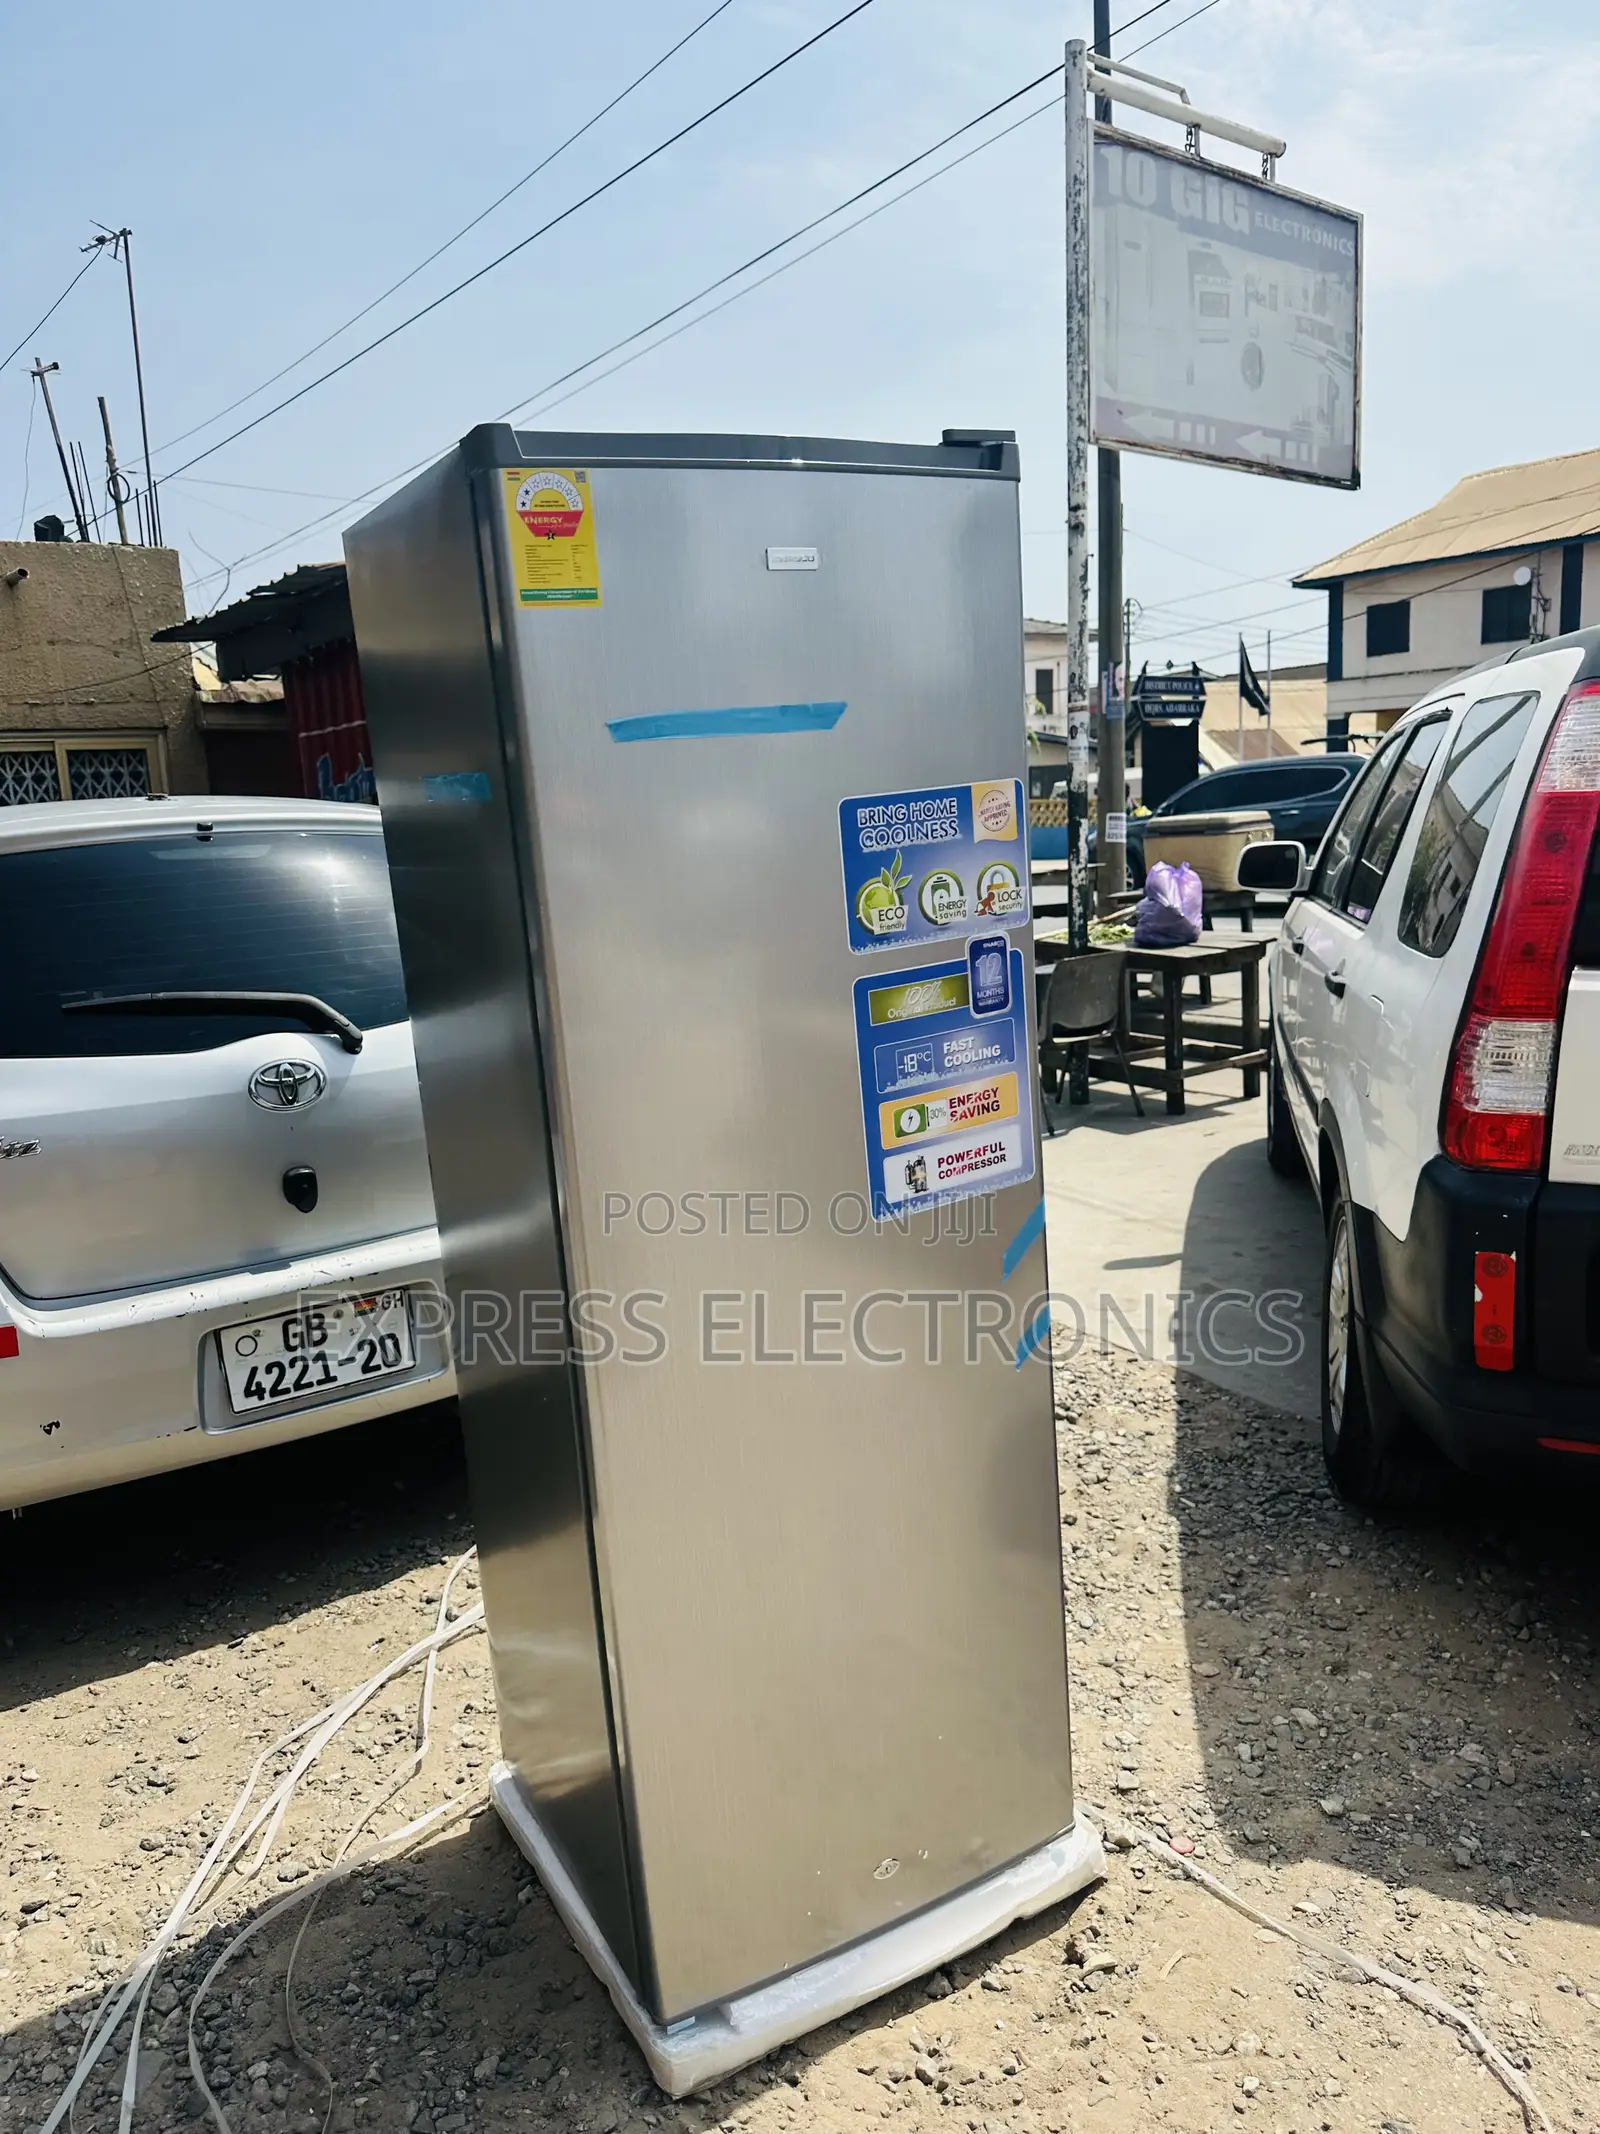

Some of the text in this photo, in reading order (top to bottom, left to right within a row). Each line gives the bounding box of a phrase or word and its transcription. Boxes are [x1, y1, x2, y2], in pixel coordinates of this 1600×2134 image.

[1100, 146, 1355, 257] 10 GIG ELECTRONICS
[525, 516, 563, 525] ENERGY
[1172, 681, 1193, 691] POLICE
[857, 797, 957, 828] BRING HOME
[859, 819, 959, 850] COOLNESS
[997, 889, 1022, 903] LOCK
[878, 906, 905, 922] ECO
[938, 899, 967, 912] ENERGY
[939, 908, 967, 920] saving
[998, 901, 1023, 912] security
[879, 919, 906, 932] friendly
[975, 952, 1003, 987] 12
[977, 987, 1005, 1000] MONTHS
[888, 1003, 923, 1018] Original
[943, 1036, 975, 1054] FAST
[944, 1044, 1001, 1068] COOLING
[949, 1087, 999, 1109] ENERGY
[929, 1106, 947, 1120] 30%
[950, 1100, 1000, 1123] SAVING
[937, 1141, 1006, 1169] POWERFUL
[938, 1153, 1007, 1180] COMPRESSOR
[381, 1293, 404, 1310] GH
[282, 1312, 329, 1352] GB
[243, 1332, 403, 1401] 4221-20
